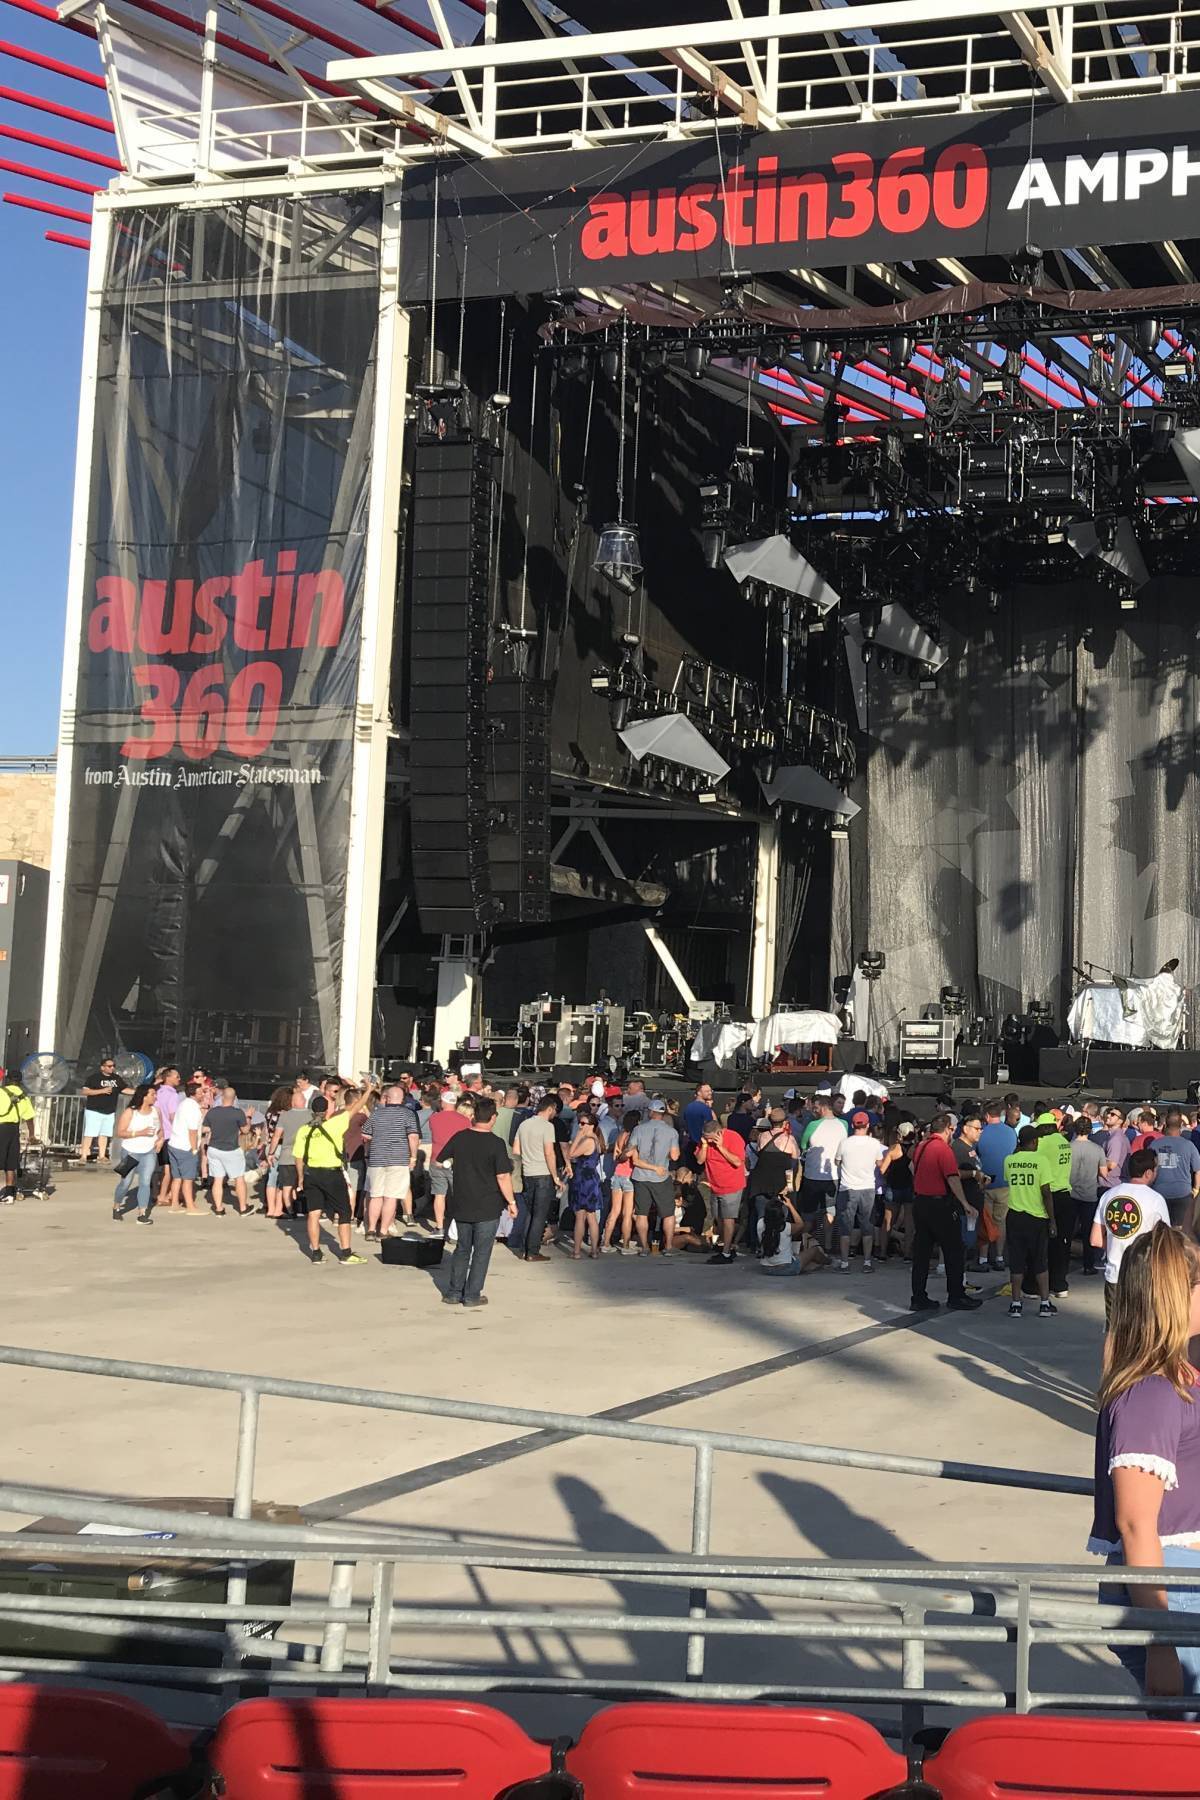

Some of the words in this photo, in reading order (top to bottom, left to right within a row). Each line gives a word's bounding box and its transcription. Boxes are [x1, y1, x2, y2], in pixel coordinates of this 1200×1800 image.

[581, 143, 989, 261] austin360
[87, 549, 345, 655] austin
[119, 661, 283, 760] 360
[84, 766, 113, 786] from
[112, 764, 172, 789] Austin
[173, 763, 322, 791] American-Statesman
[1011, 1173, 1034, 1186] 230
[1106, 1210, 1138, 1224] DEAD
